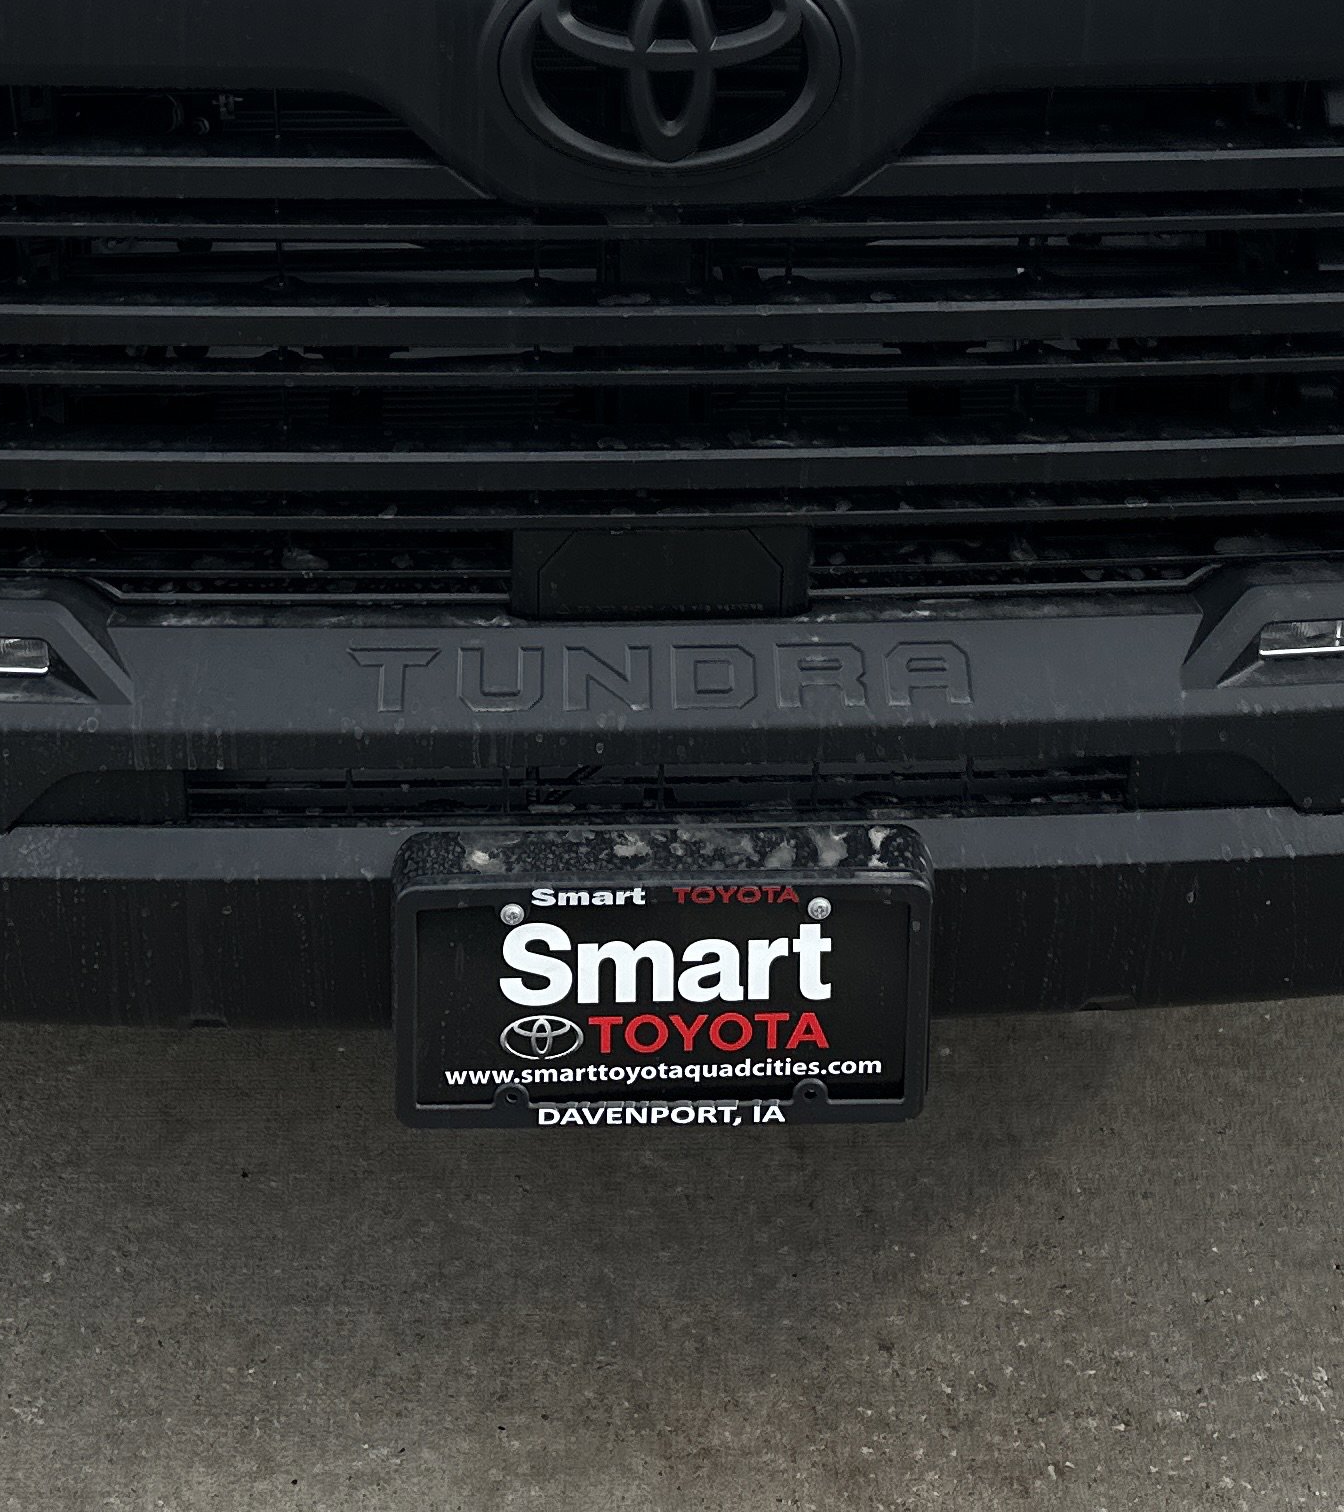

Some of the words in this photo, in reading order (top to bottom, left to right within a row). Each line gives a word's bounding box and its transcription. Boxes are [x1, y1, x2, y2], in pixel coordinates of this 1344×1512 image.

[346, 640, 975, 713] TUNDRA
[530, 887, 646, 907] Smart
[672, 885, 800, 905] TOYOTA
[499, 922, 833, 1007] Smart
[588, 1012, 831, 1054] TOYOTA
[444, 1056, 883, 1086] www.smarttoyotaquadcities.com
[537, 1104, 743, 1127] DAVENPORT,
[752, 1103, 786, 1124] IA
